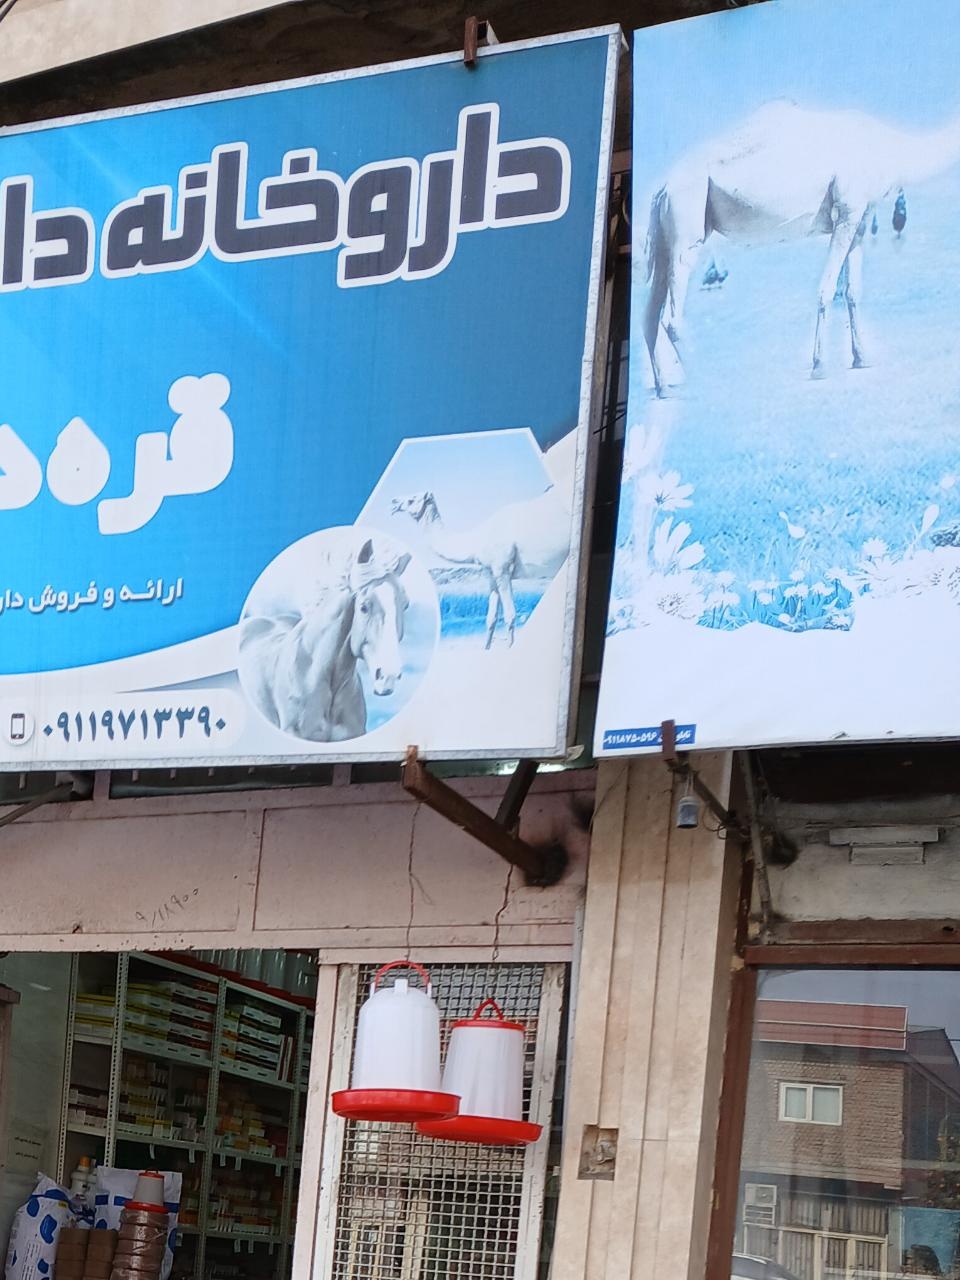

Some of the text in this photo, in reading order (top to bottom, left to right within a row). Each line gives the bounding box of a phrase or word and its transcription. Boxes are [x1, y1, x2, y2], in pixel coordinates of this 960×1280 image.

[100, 103, 571, 288] داروخانه
[46, 373, 234, 535] قره
[28, 581, 98, 612] فروش
[103, 587, 115, 608] و
[42, 705, 227, 743] ۰۹۱۱۹۷۱۳۳۹۰
